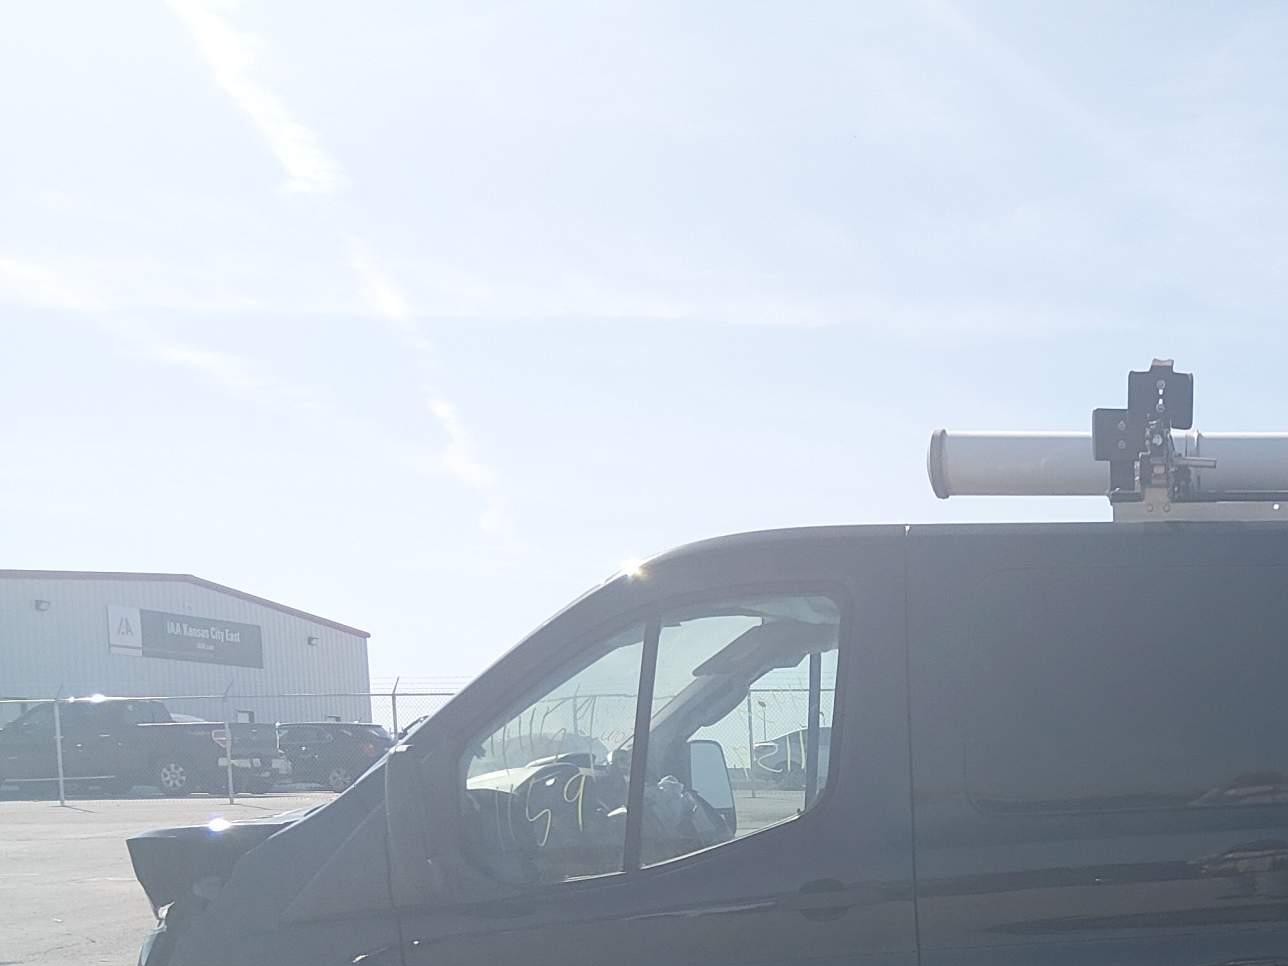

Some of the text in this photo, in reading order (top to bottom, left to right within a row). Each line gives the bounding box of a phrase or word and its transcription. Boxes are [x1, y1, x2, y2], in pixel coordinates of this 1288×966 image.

[182, 624, 210, 639] Kansas
[211, 627, 224, 642] City
[225, 629, 241, 643] East
